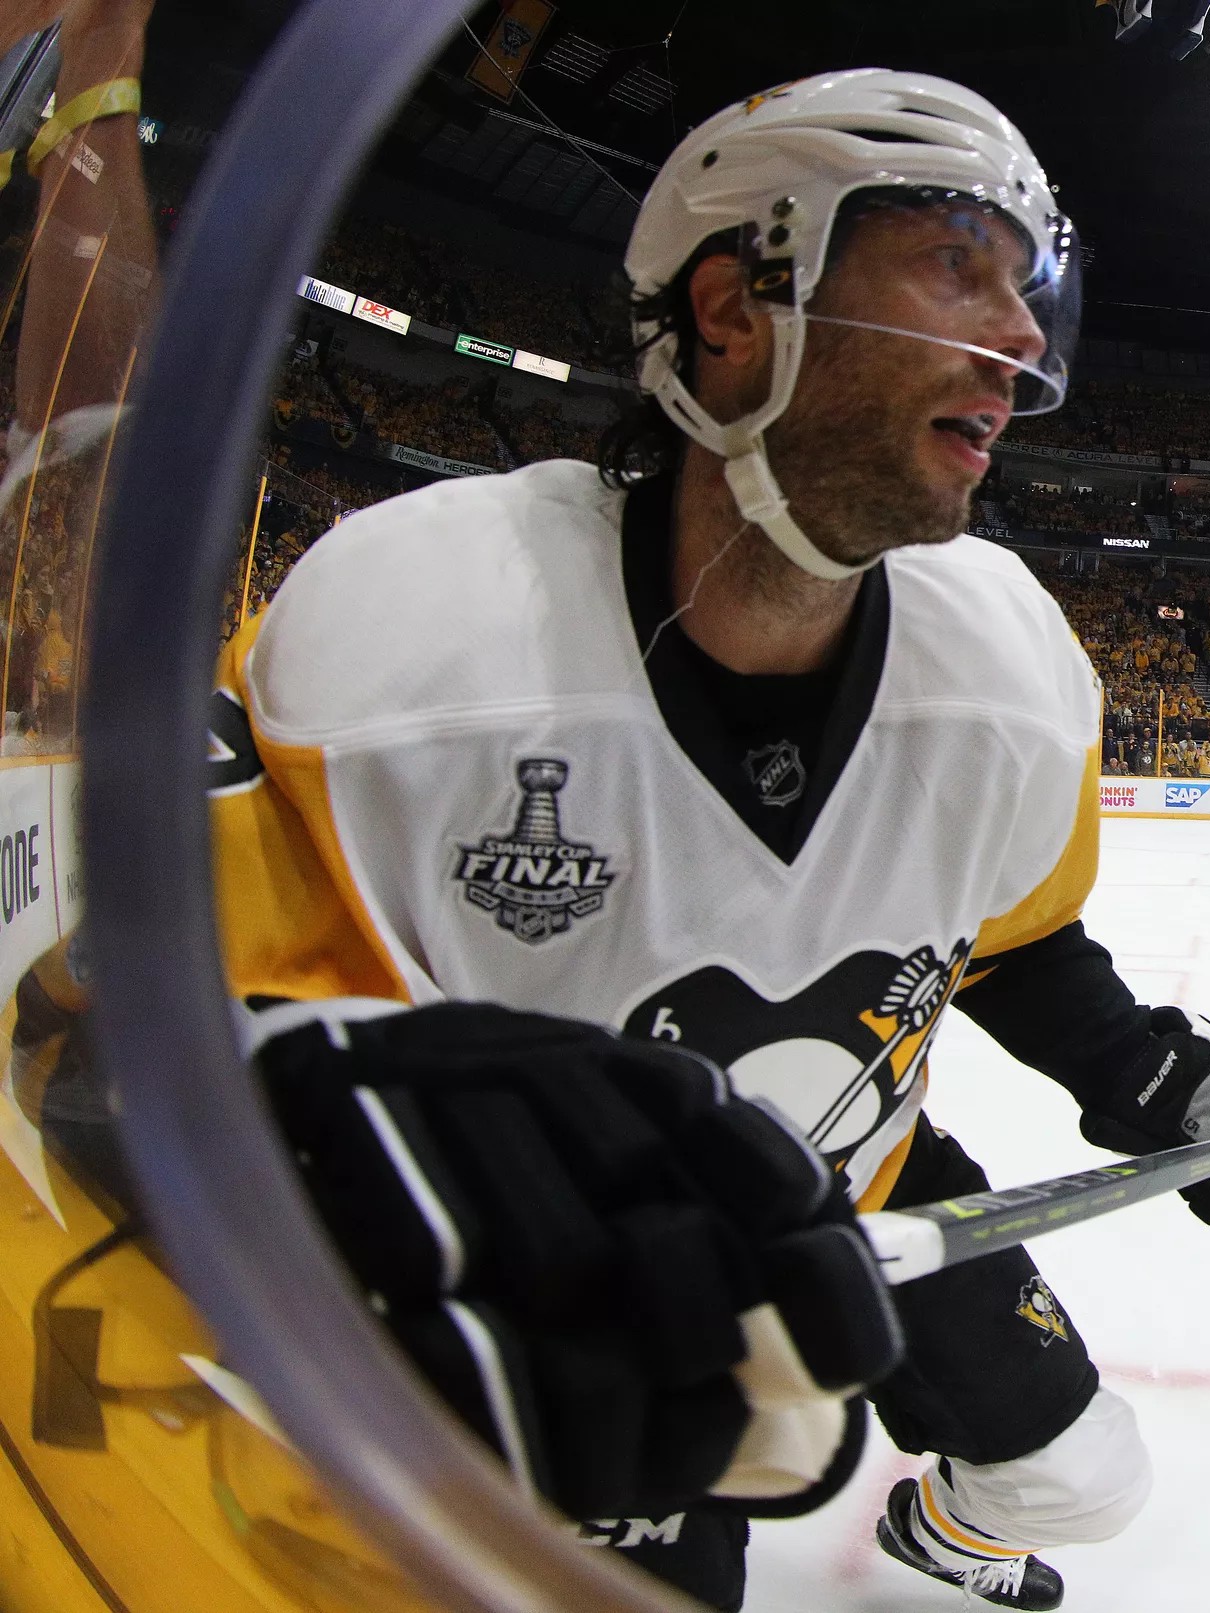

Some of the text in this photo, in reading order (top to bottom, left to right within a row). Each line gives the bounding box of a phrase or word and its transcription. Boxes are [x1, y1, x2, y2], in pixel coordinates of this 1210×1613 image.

[304, 279, 347, 311] datablue
[362, 300, 394, 320] DEX
[460, 340, 510, 360] enterprise
[395, 446, 439, 468] Remington
[967, 526, 1014, 538] LEVEL
[1103, 537, 1150, 548] NISSAN
[761, 755, 791, 793] NHL
[1166, 787, 1202, 804] SAP
[484, 840, 593, 860] STANLEY CUP
[462, 852, 609, 888] FINAL
[1137, 1050, 1178, 1107] BAUER
